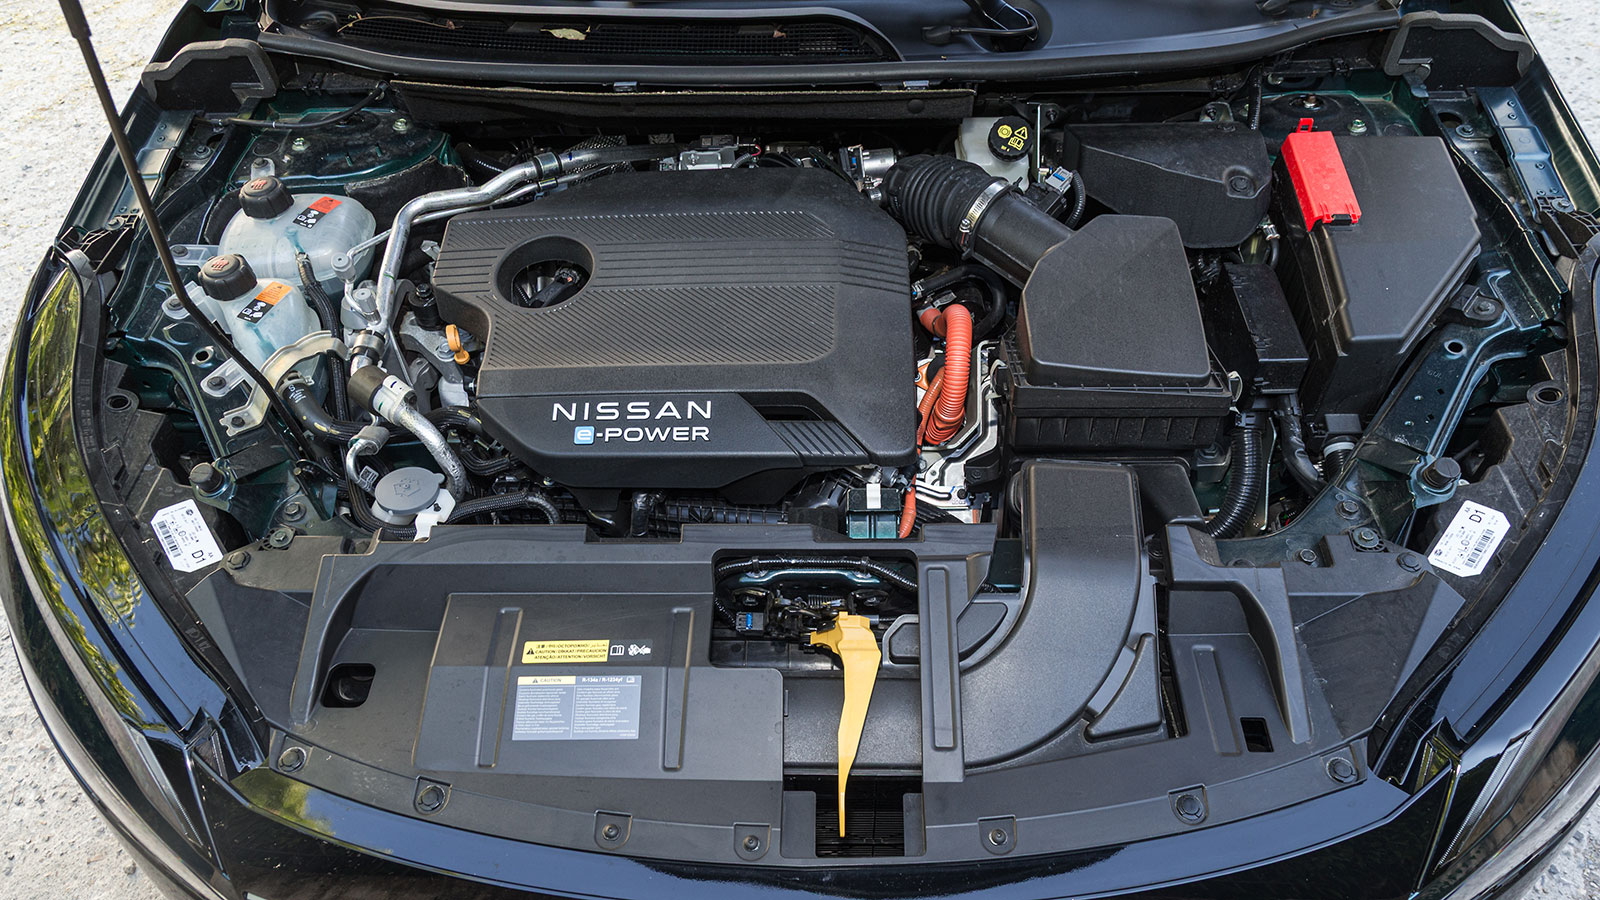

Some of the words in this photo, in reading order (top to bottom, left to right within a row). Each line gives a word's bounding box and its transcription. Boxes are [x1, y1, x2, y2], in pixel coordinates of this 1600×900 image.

[552, 400, 712, 421] NISSAN
[575, 426, 710, 443] e-POWER
[1469, 509, 1486, 523] D1
[191, 549, 206, 564] D1
